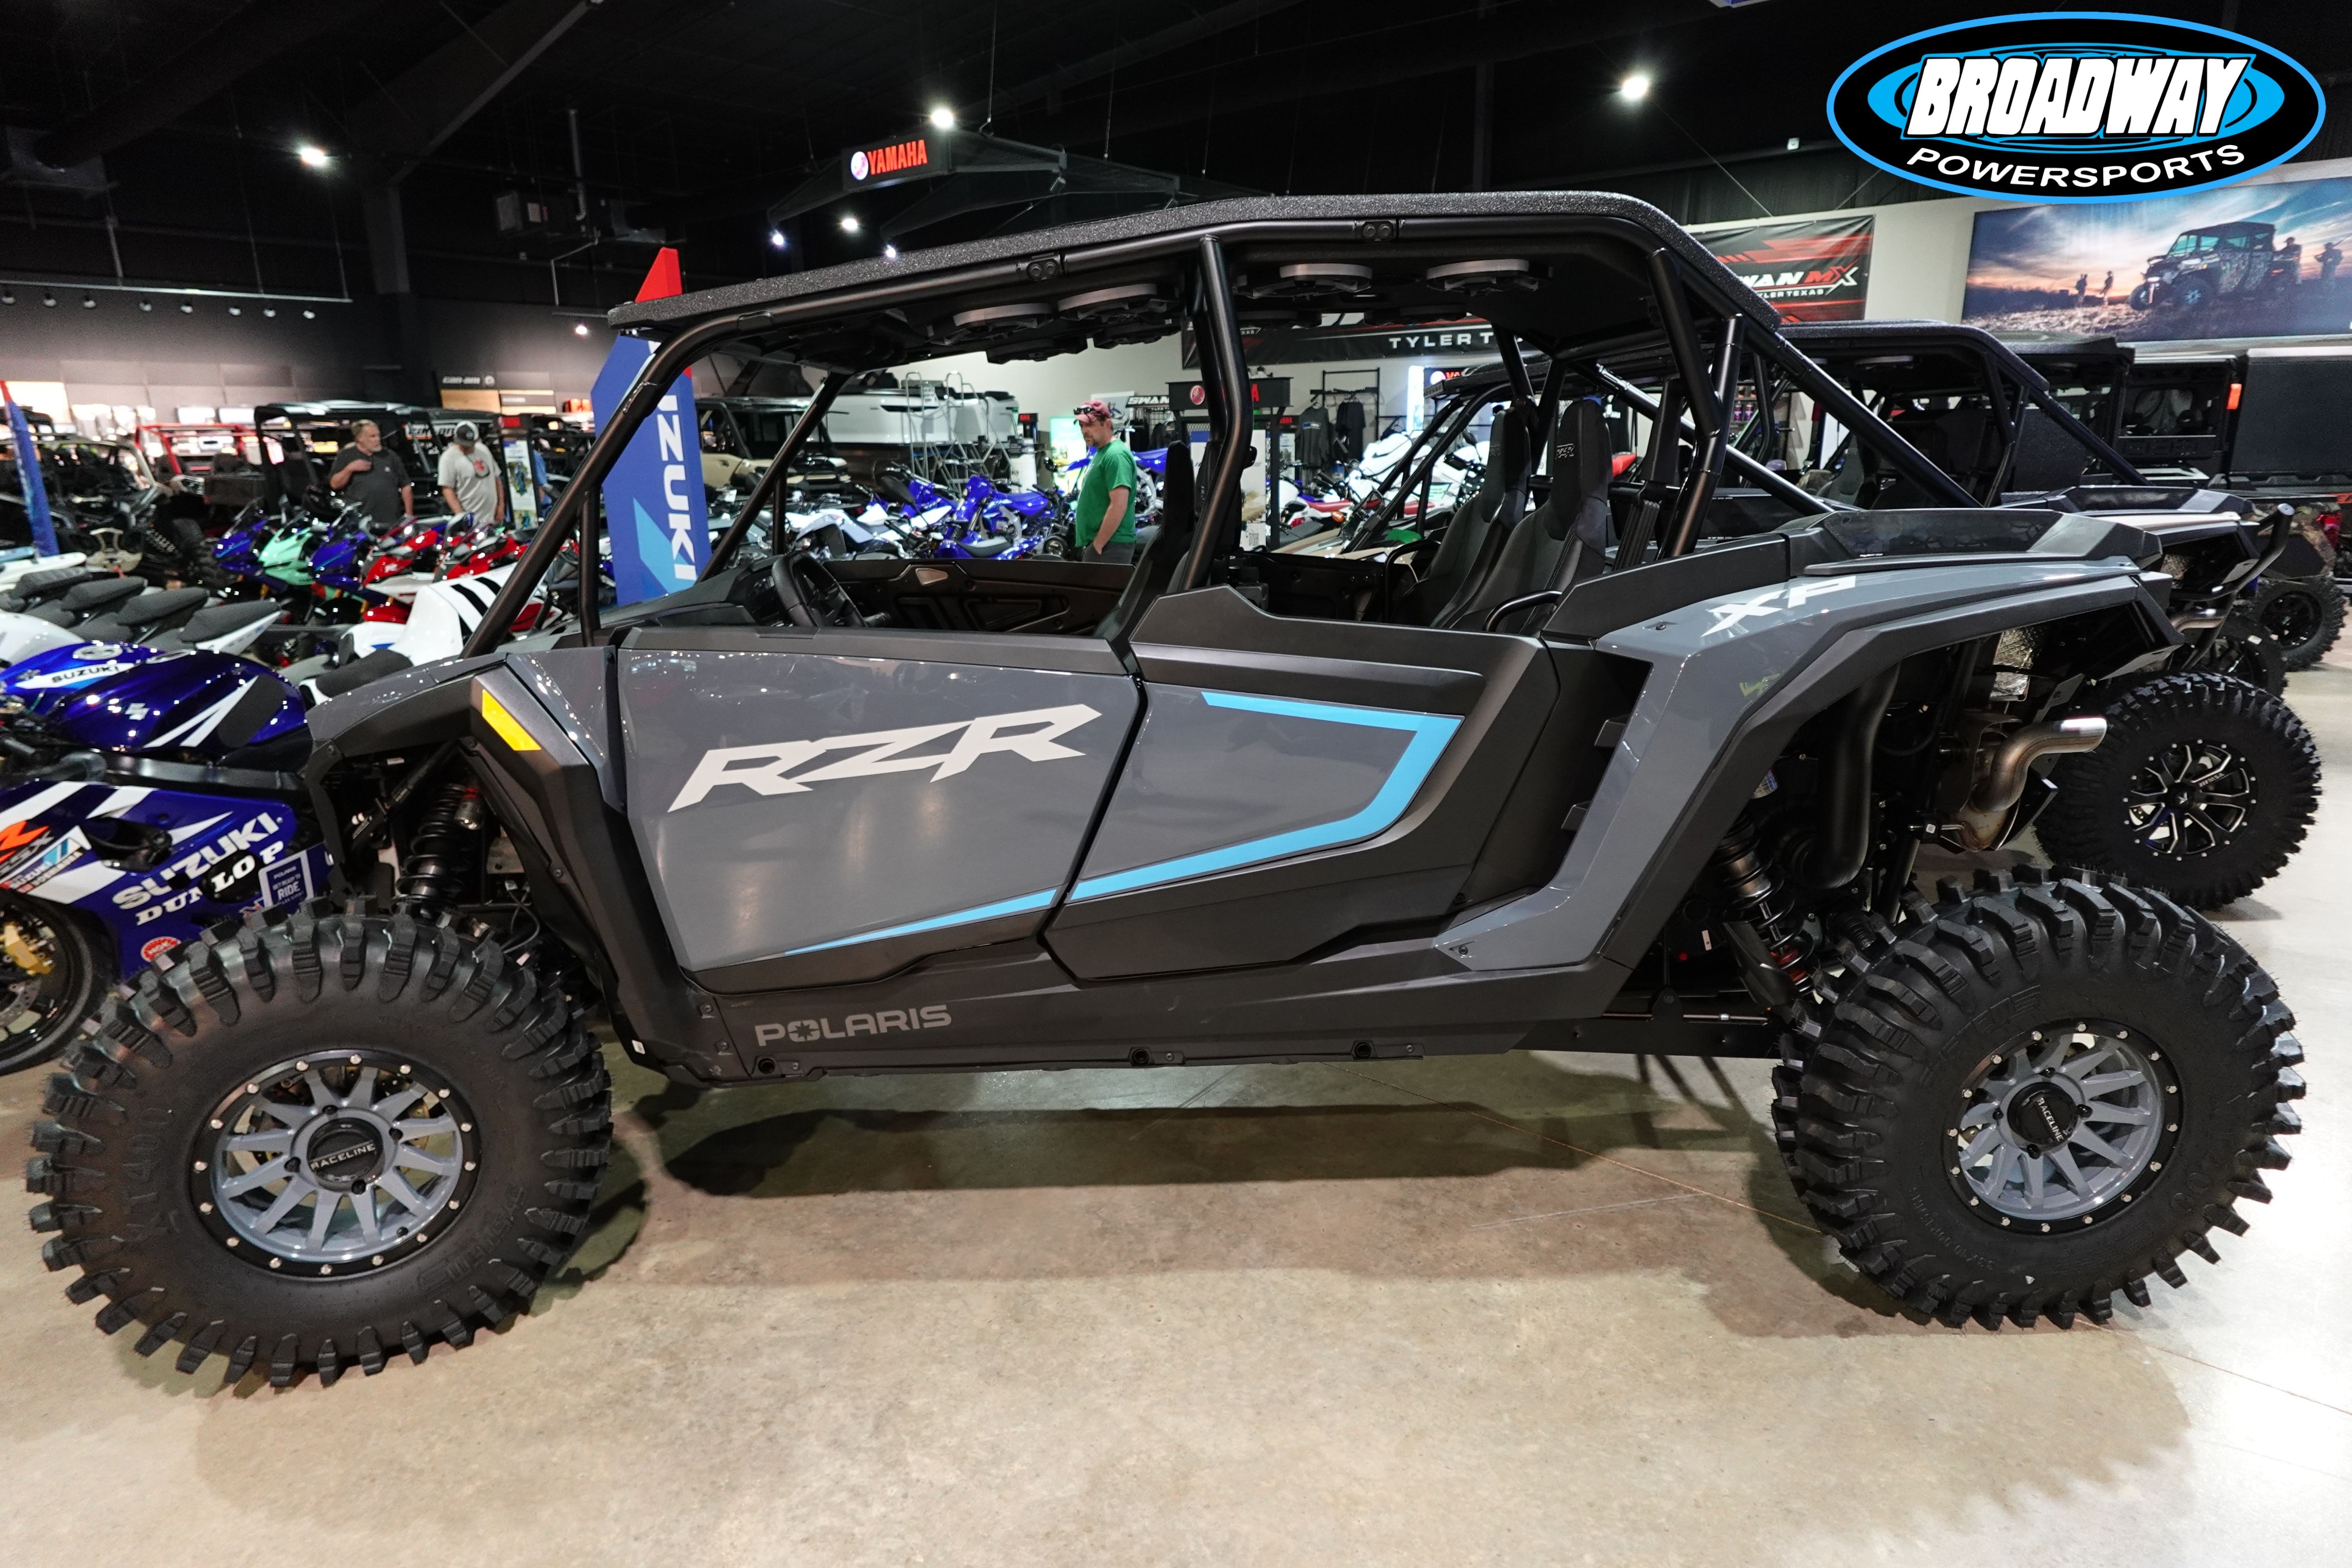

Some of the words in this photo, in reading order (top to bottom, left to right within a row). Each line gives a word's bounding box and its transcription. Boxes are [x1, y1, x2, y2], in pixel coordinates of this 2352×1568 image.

[867, 140, 928, 175] YAMAHA
[1737, 272, 1804, 288] WAN
[1389, 333, 1472, 349] TYLER
[648, 340, 697, 581] ZUKI
[1701, 575, 1856, 637] XP
[52, 666, 119, 683] SUZUKI
[667, 704, 1103, 813] RZR
[112, 812, 279, 910] SUZUKI
[135, 840, 284, 926] DUNLOP
[277, 881, 300, 900] RIDE
[754, 1004, 952, 1047] POLARIS
[2037, 1097, 2064, 1142] RACELINE
[310, 1142, 376, 1171] RACELINE
